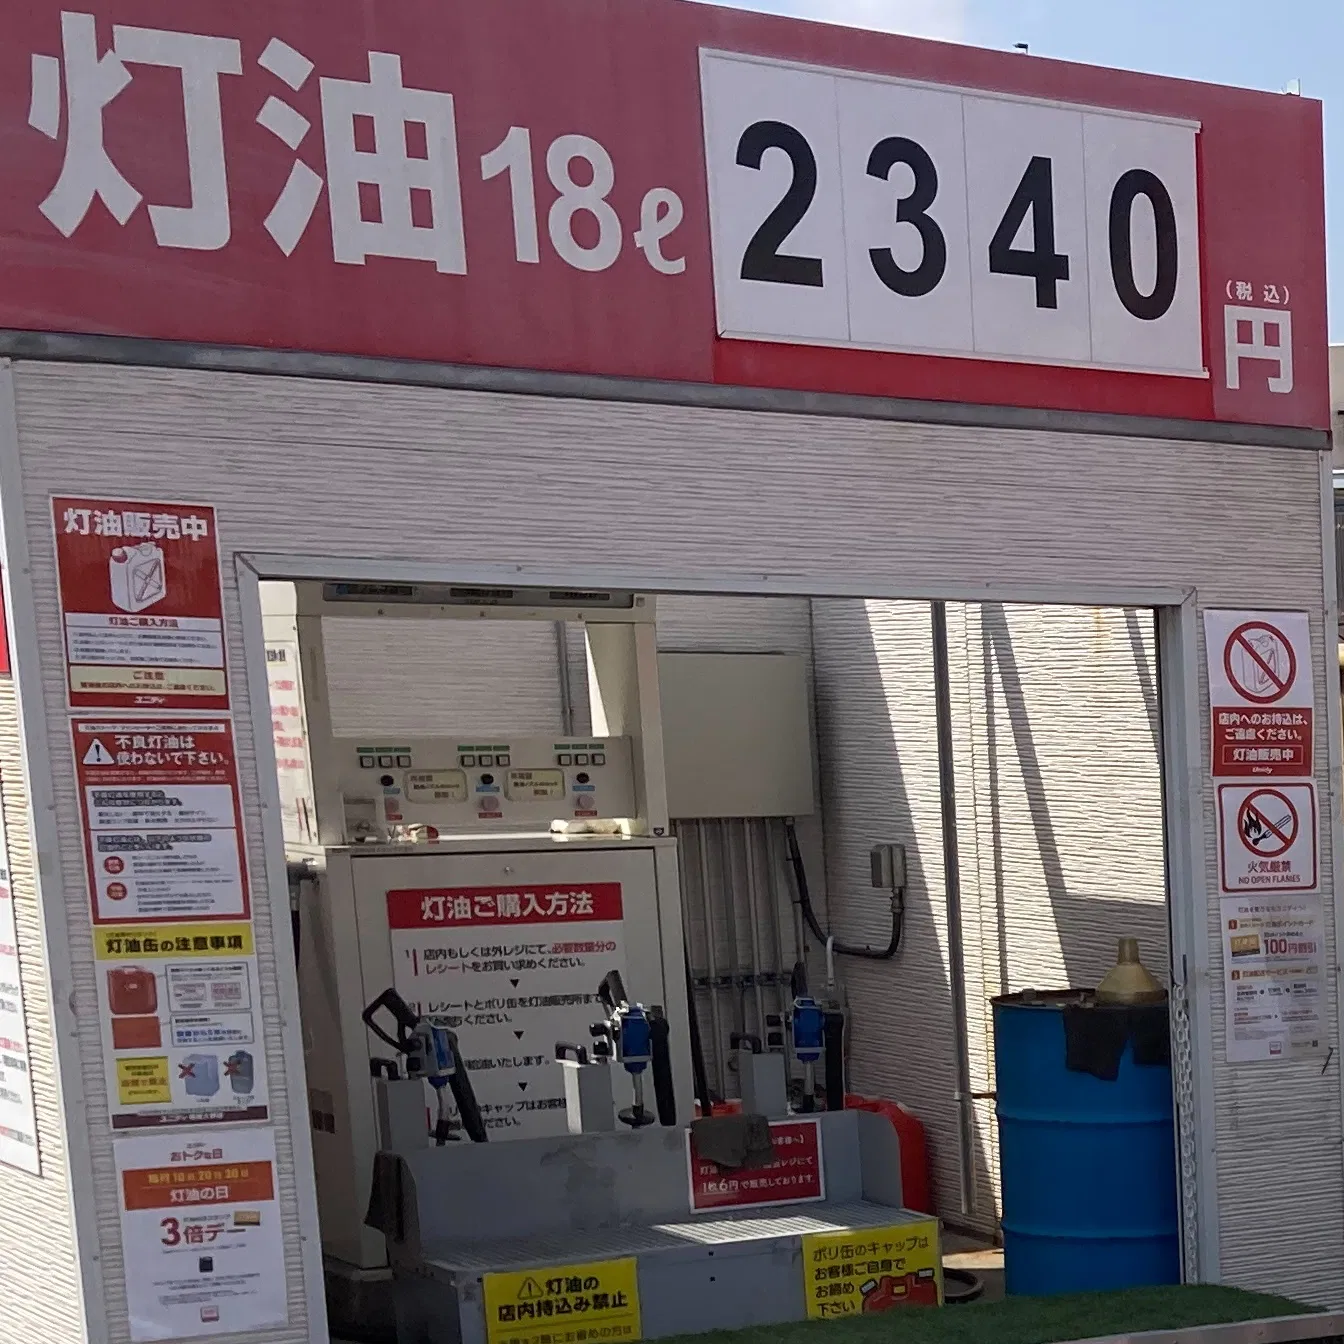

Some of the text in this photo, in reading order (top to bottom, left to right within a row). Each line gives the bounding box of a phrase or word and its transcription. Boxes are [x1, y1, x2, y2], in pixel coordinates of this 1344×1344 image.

[28, 10, 468, 275] 灯油
[735, 120, 1179, 321] 2340
[1224, 304, 1294, 394] 円
[63, 507, 209, 542] 灯油販売中
[115, 734, 196, 750] 不良灯油は
[116, 751, 230, 767] 使わないで下さい。
[1232, 748, 1294, 762] 灯油販売中
[1247, 860, 1292, 874] 火気厳禁
[1238, 874, 1301, 885] NO OPEN FLAMES
[420, 891, 595, 921] 灯油ご購入方法
[106, 934, 243, 954] 灯油缶の注意事項
[169, 1185, 229, 1202] 灯油の日
[813, 1236, 930, 1262] ポリ缶のキャップは
[815, 1257, 907, 1281] お客様ご自身で
[545, 1276, 600, 1296] 灯油の
[498, 1290, 628, 1322] 店内持込み禁止
[816, 1300, 856, 1317] 下さい
